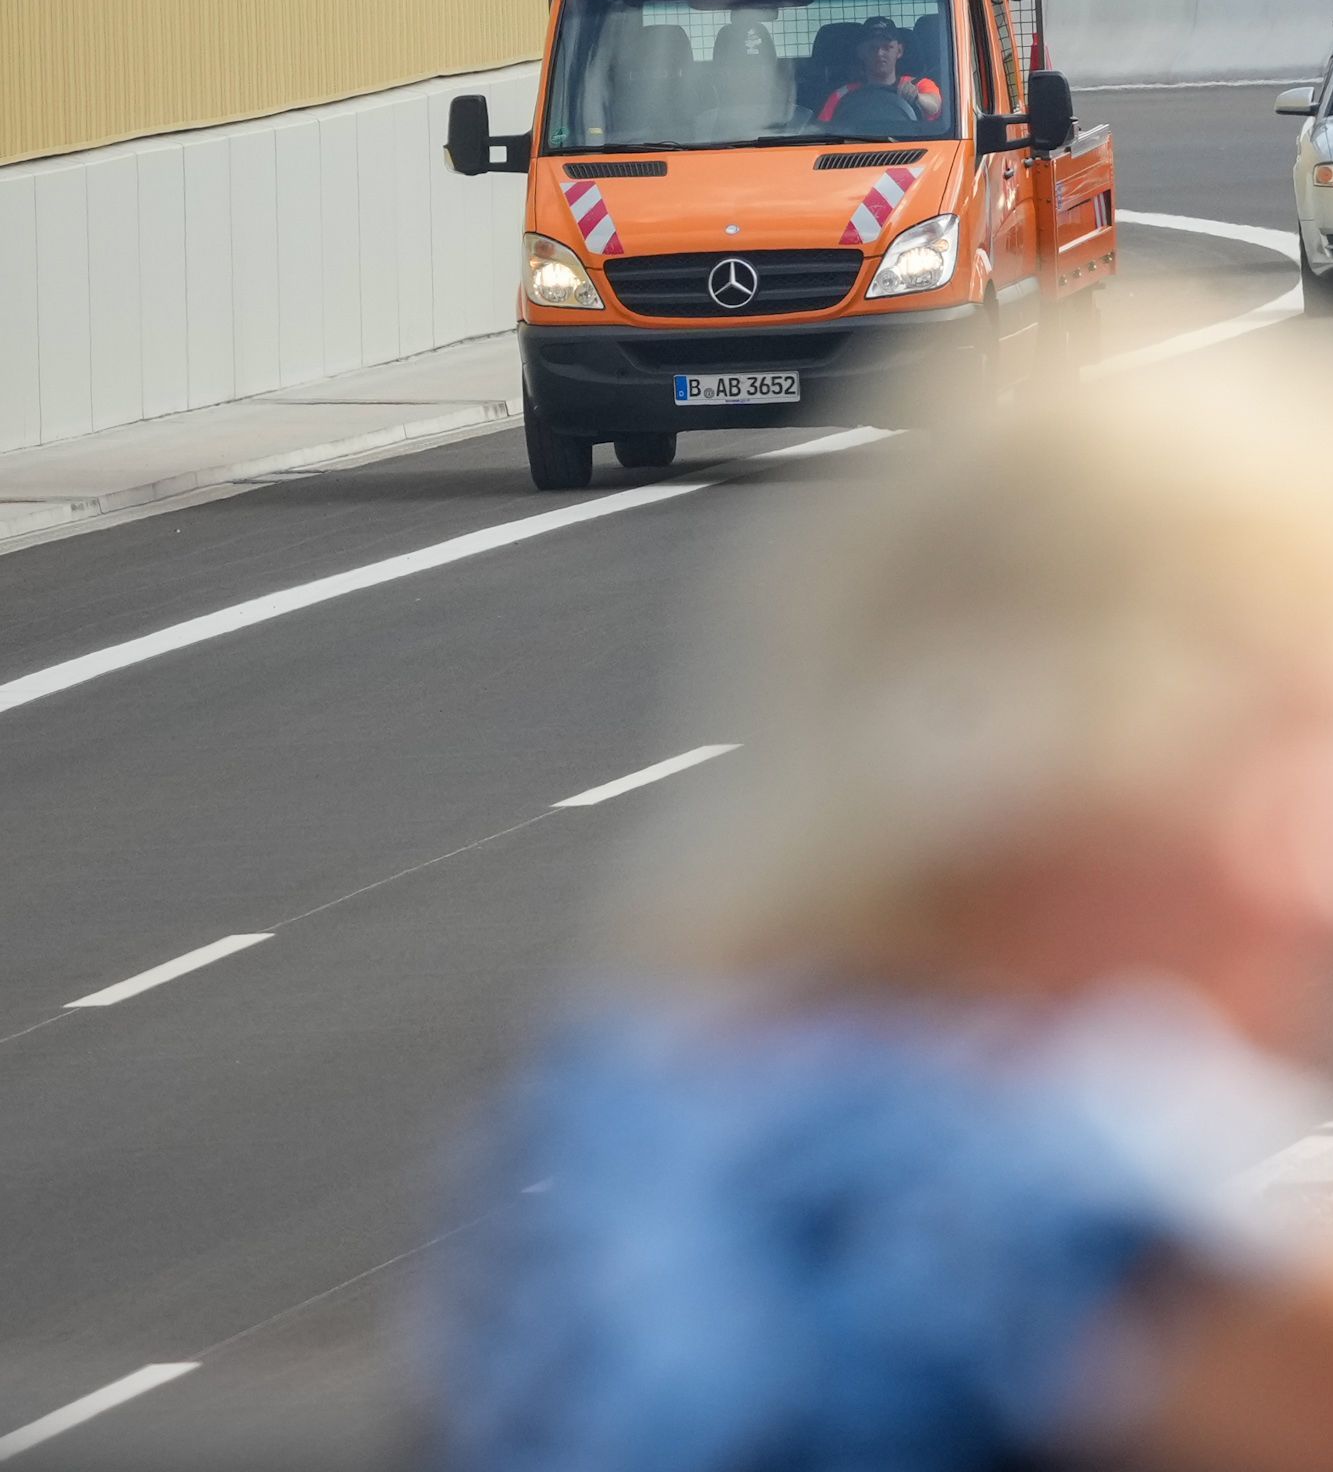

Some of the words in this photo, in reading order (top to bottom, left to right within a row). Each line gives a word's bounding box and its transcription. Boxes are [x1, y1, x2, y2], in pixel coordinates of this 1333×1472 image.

[688, 379, 701, 397] B
[716, 377, 741, 397] AB
[746, 375, 796, 396] 3652
